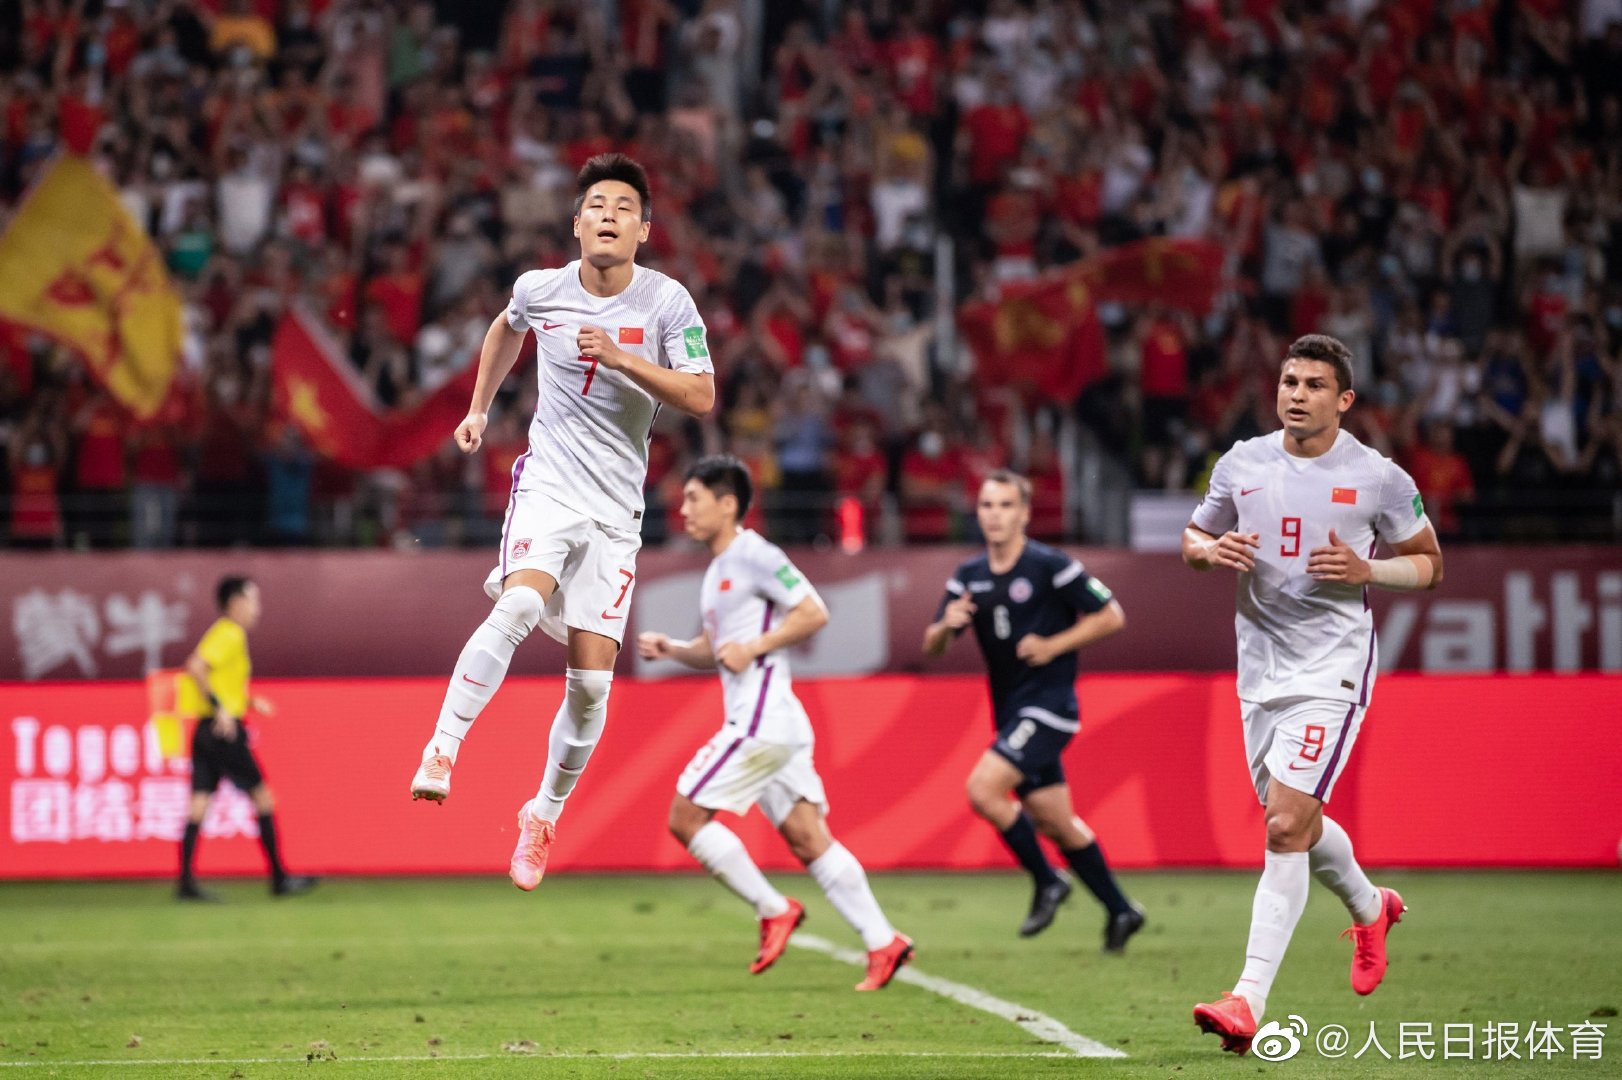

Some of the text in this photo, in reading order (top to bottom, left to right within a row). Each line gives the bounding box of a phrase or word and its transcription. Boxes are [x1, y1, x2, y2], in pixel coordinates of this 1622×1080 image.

[577, 356, 598, 396] 7
[1281, 517, 1301, 557] 9
[613, 568, 634, 609] 7
[1299, 724, 1325, 762] 9
